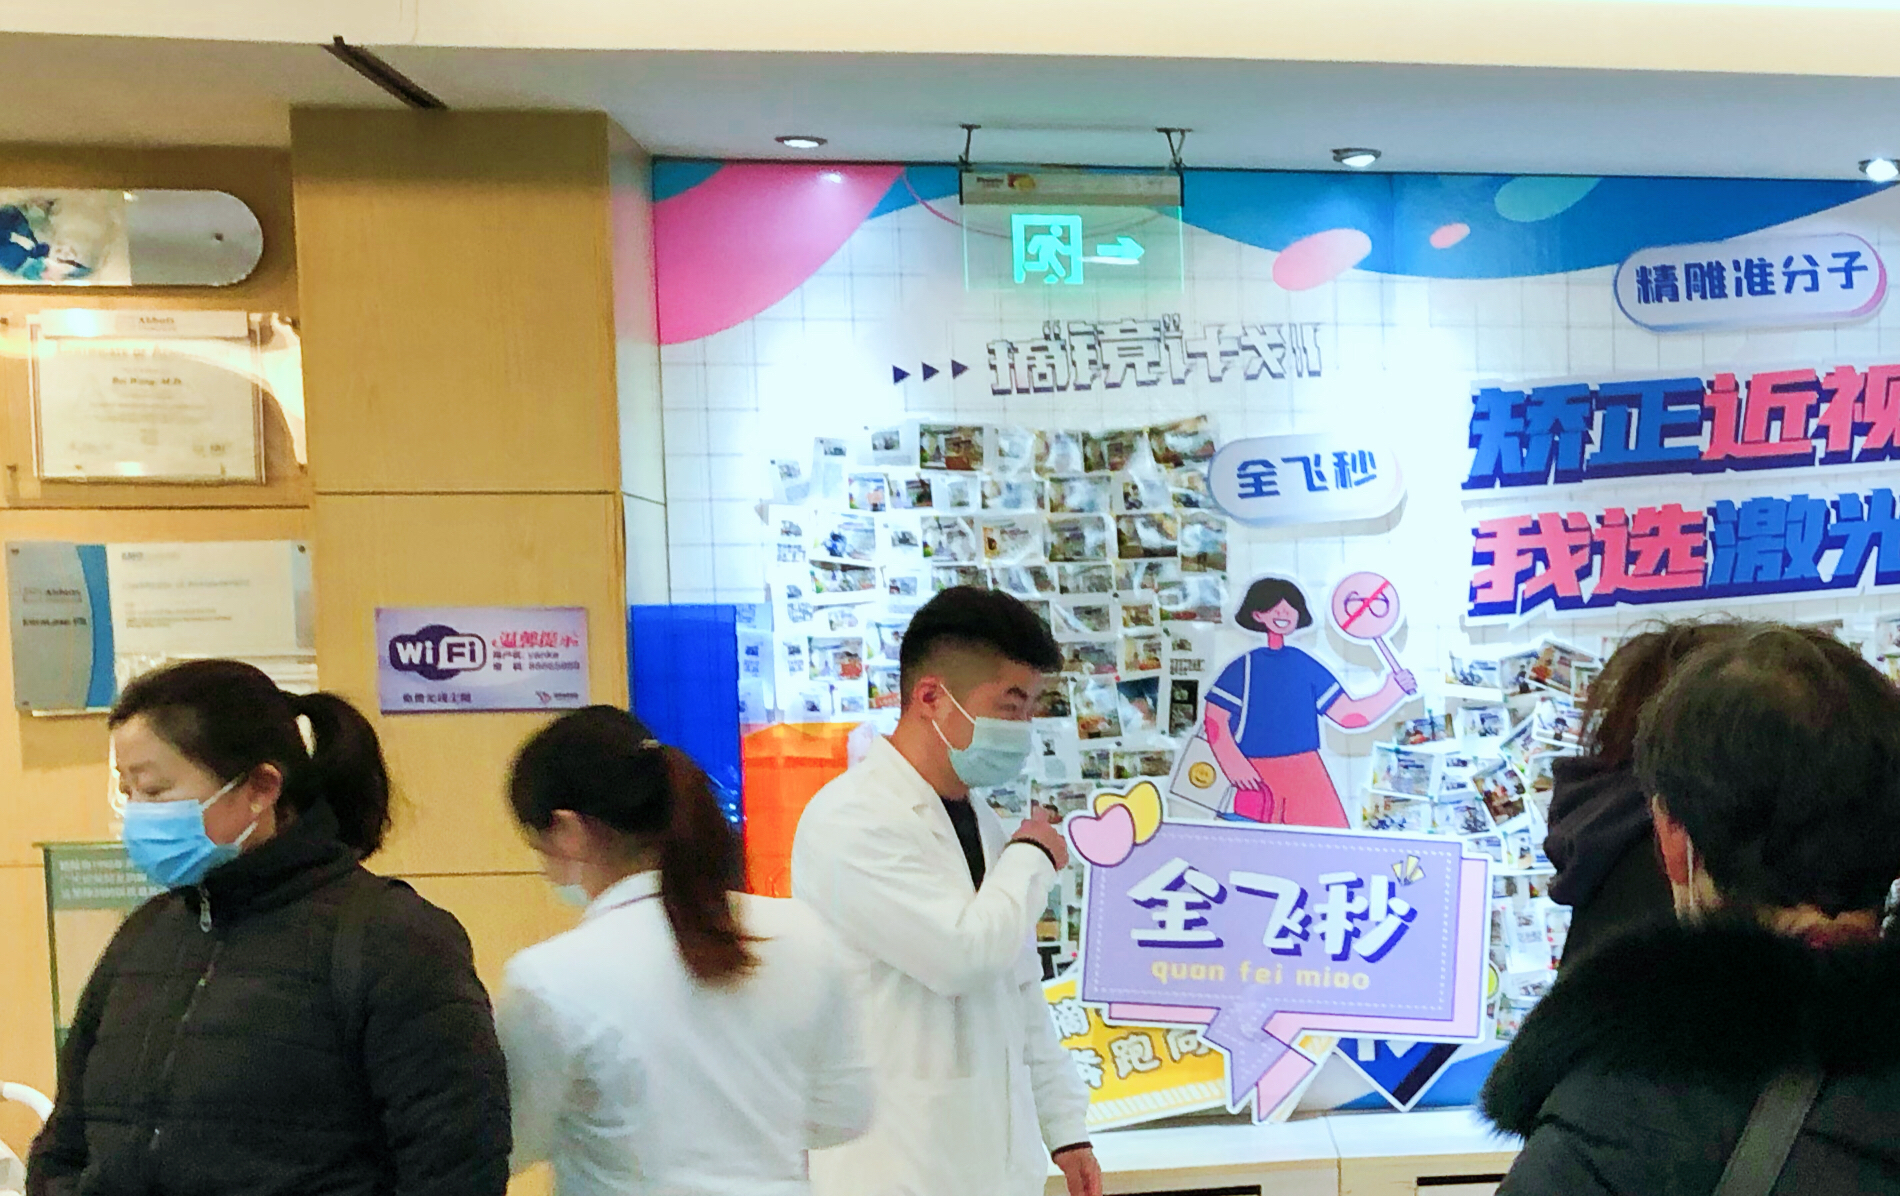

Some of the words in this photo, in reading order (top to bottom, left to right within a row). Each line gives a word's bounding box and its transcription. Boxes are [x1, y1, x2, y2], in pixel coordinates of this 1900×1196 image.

[1636, 251, 1868, 304] 精雕准分子
[1237, 450, 1377, 499] 全飞秒
[1127, 857, 1418, 963] 全飞秒
[1151, 960, 1225, 985] quan
[1240, 960, 1283, 984] fei
[1296, 966, 1370, 990] miao
